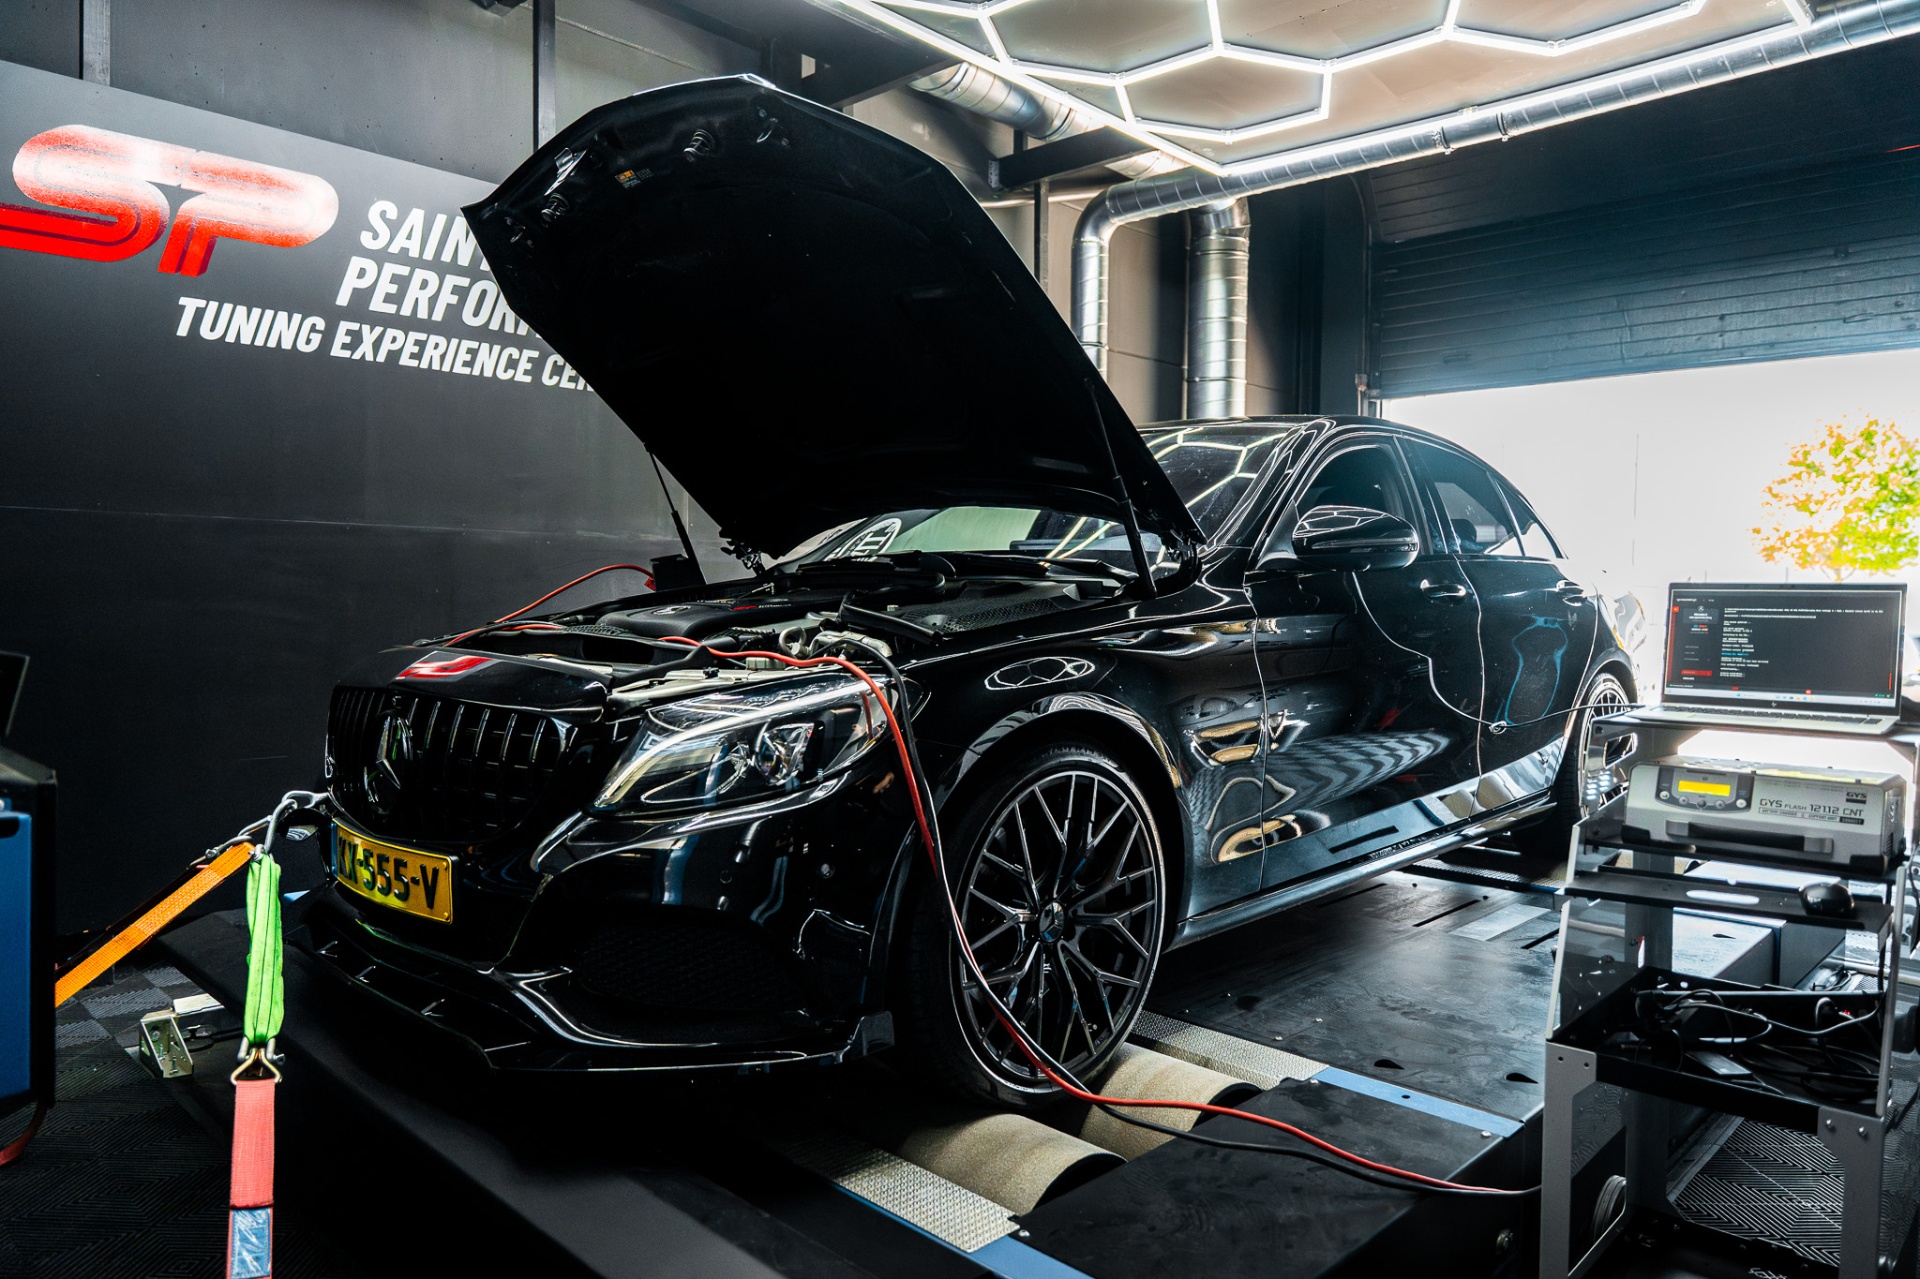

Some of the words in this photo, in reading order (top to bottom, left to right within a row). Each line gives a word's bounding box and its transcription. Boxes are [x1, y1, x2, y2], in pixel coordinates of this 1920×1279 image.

[0, 124, 339, 277] SP
[360, 200, 491, 271] SAIN
[176, 296, 327, 354] TUNING
[331, 321, 540, 383] EXPERIENCE
[1759, 798, 1783, 808] GYS
[1784, 803, 1807, 811] FLASH
[1842, 807, 1864, 817] CNT
[1846, 791, 1867, 799] GYS
[338, 835, 440, 911] KX-555-V
